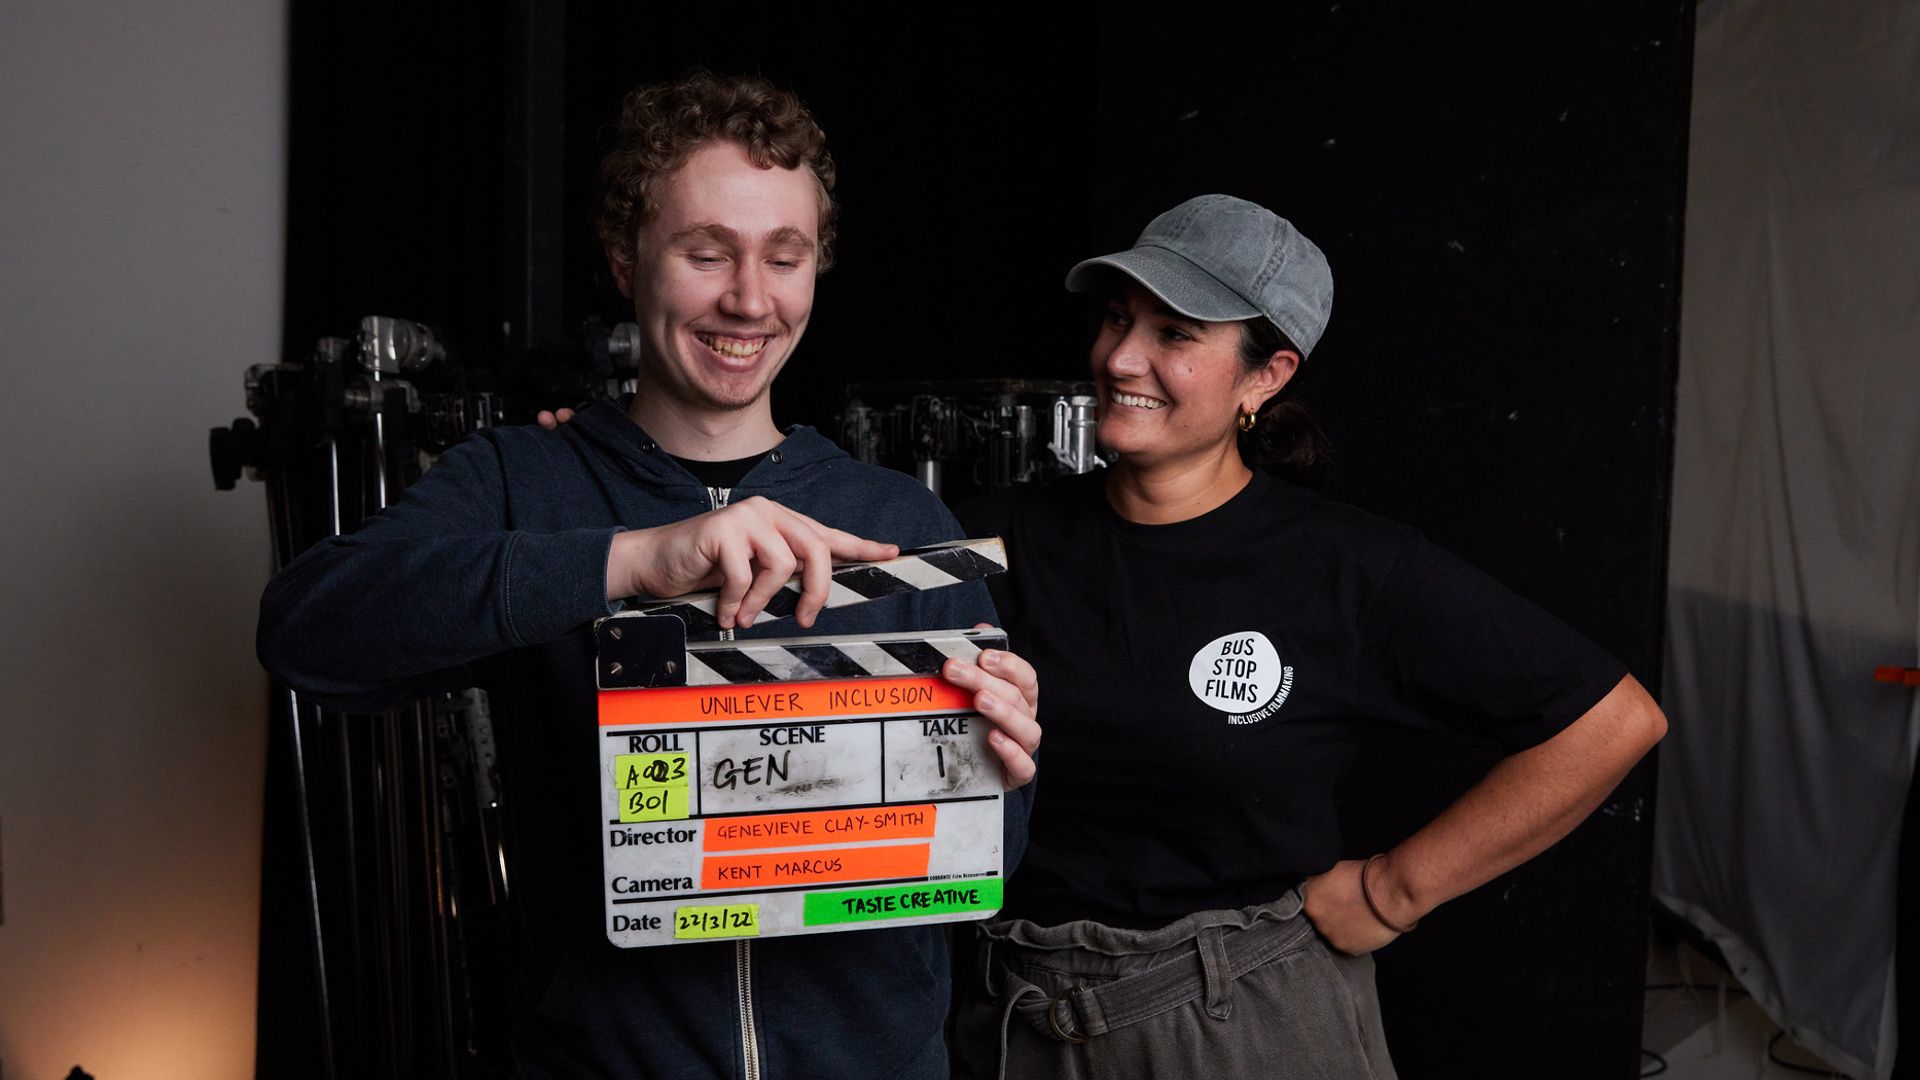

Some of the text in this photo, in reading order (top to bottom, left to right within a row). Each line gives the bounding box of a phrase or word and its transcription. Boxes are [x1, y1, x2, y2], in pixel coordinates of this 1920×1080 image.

[1220, 638, 1255, 656] BUS
[1212, 658, 1257, 679] STOP
[700, 686, 933, 715] UNILEVER INCLUSION
[1205, 679, 1258, 704] FILMS
[1227, 666, 1294, 725] INCLUSIVE FILMMAKING
[759, 726, 826, 746] SCENE
[919, 718, 968, 737] TAKE
[629, 734, 684, 753] ROLL
[713, 749, 791, 790] GEN
[717, 812, 924, 839] GENEVIEVE CLAY-SMITH
[610, 827, 697, 847] Director
[718, 858, 842, 881] KENT MARCUS
[611, 875, 694, 894] Camera
[842, 889, 981, 915] TASTE CREATIVE
[612, 913, 662, 932] Date
[679, 908, 752, 932] 22/3/22
